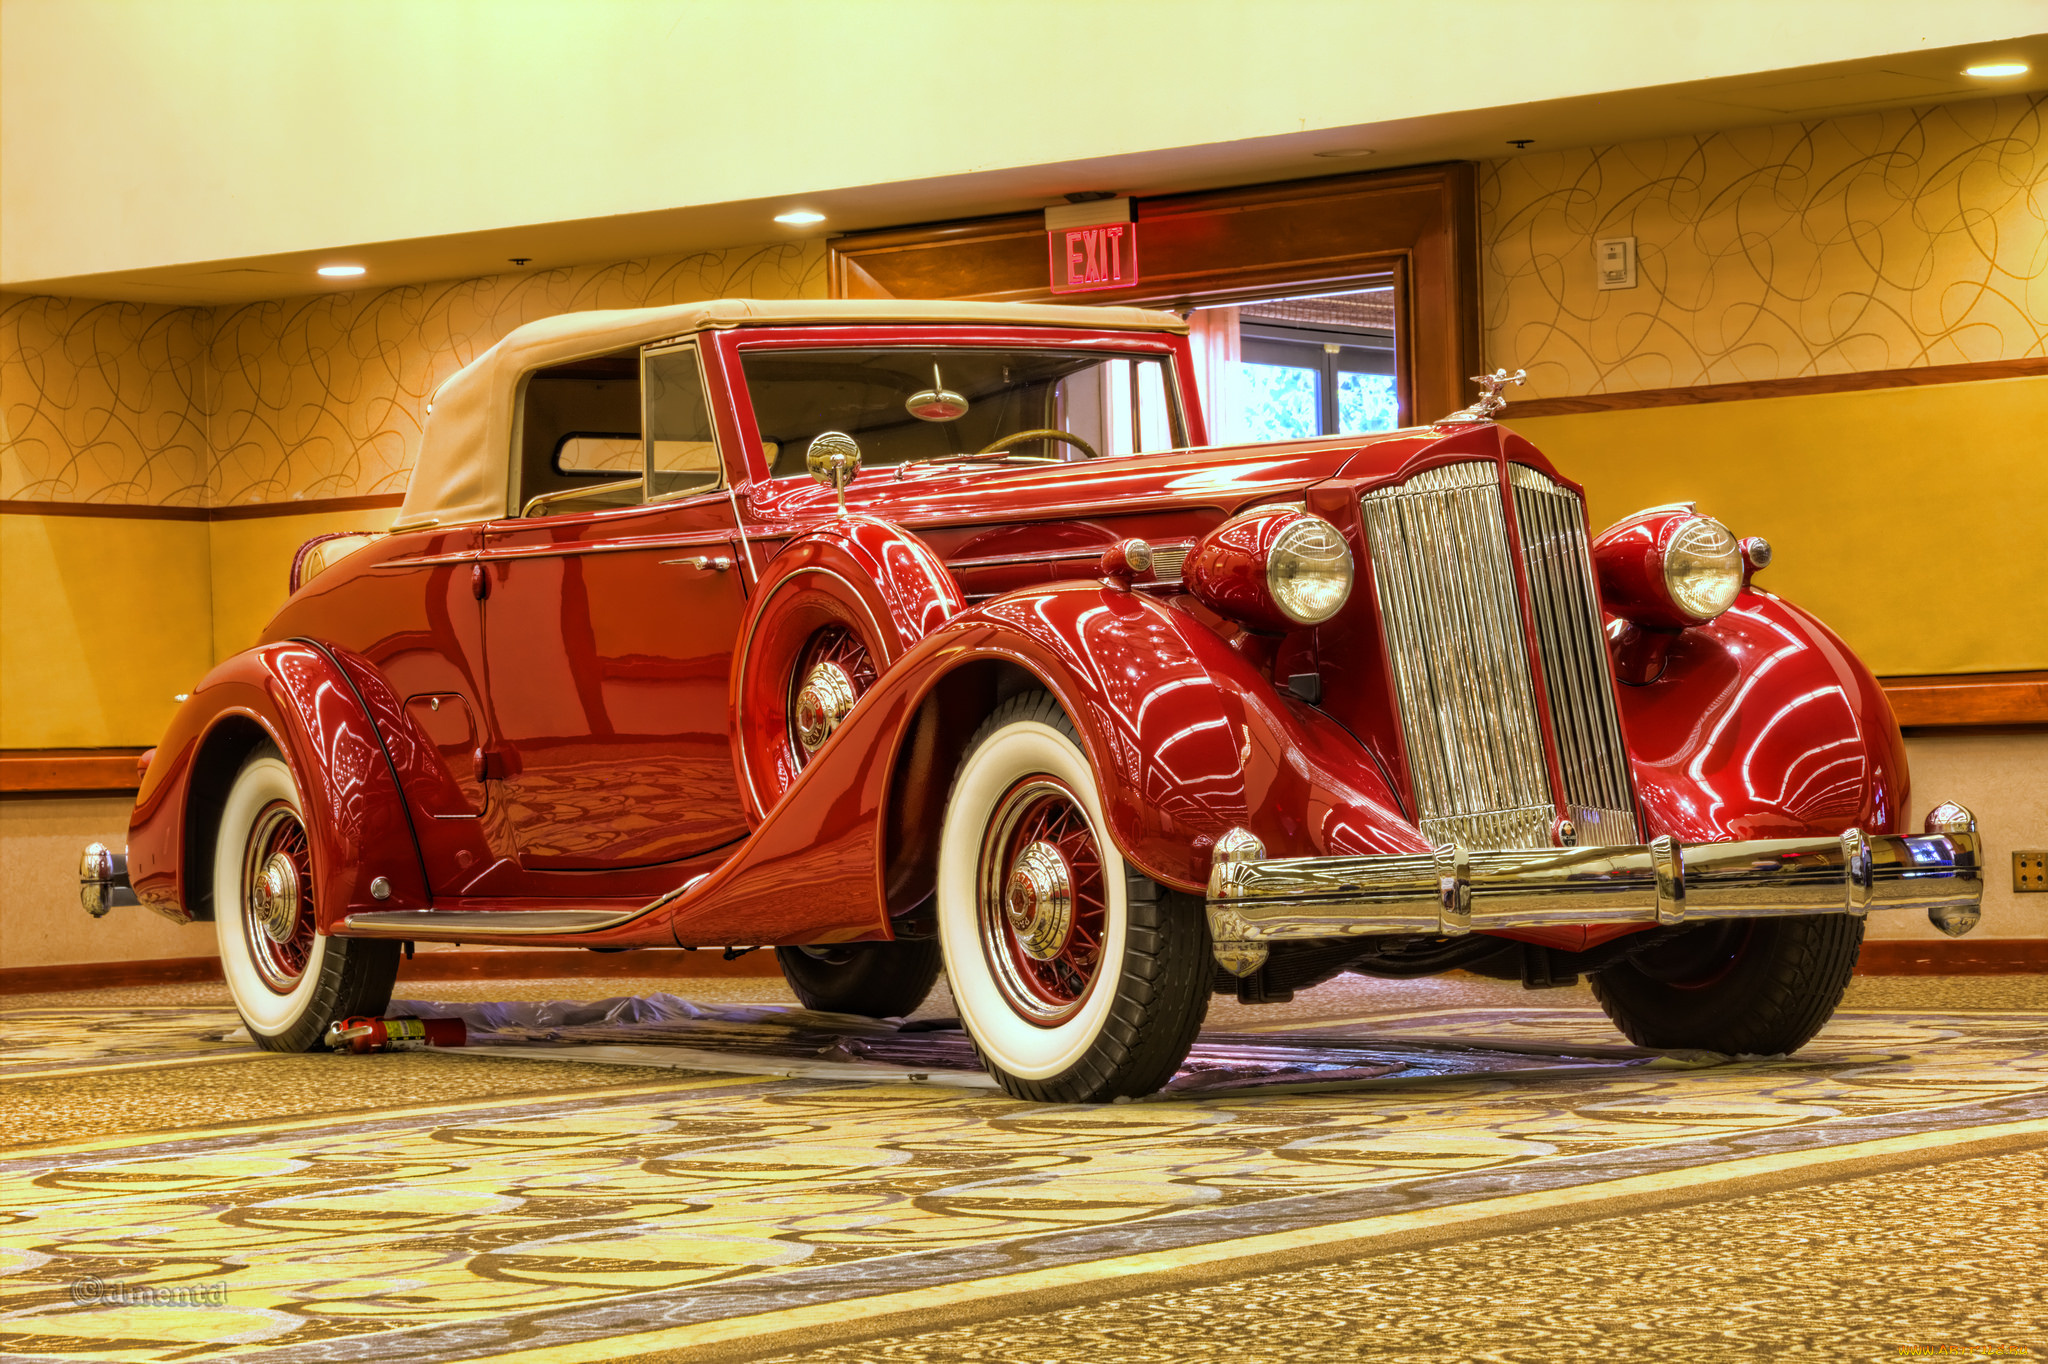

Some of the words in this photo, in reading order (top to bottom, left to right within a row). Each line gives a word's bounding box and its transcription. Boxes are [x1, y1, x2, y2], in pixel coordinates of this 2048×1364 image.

[1066, 226, 1123, 285] EXIT
[797, 693, 820, 711] CKARD
[799, 722, 822, 744] ELVE
